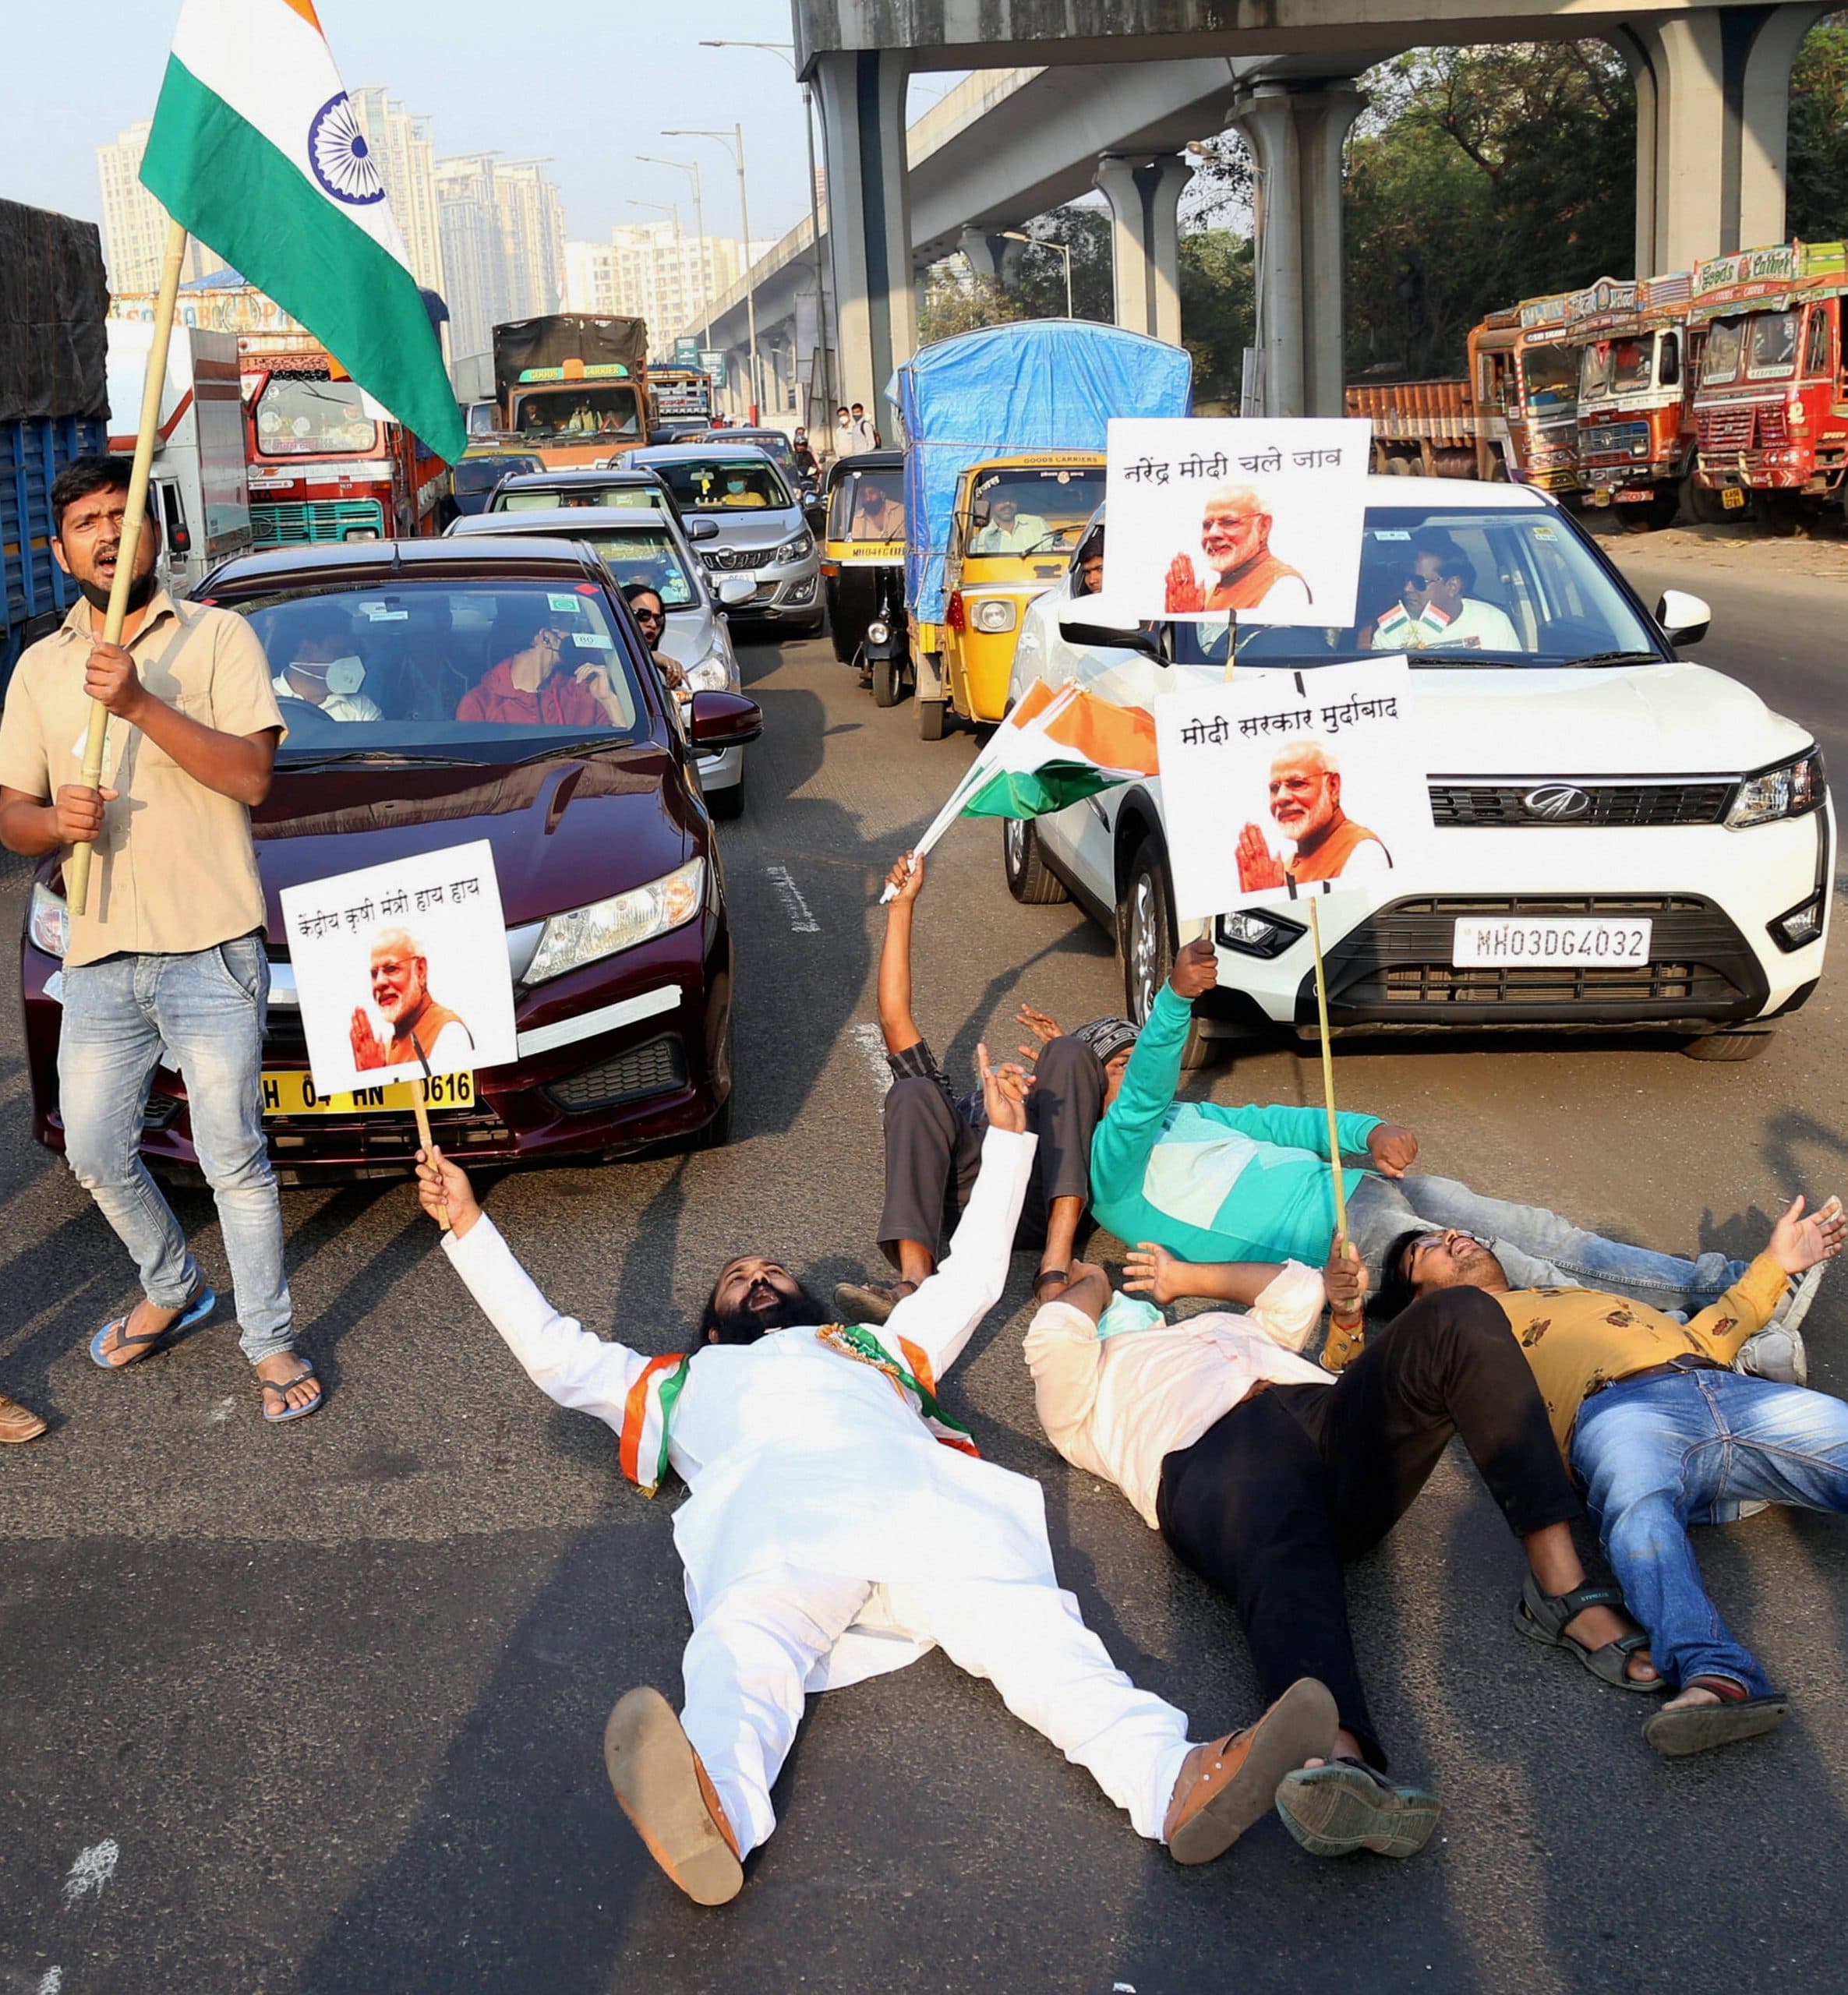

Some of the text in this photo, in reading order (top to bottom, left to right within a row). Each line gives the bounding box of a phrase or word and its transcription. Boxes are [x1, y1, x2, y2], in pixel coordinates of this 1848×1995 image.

[1124, 446, 1343, 486] नरेंद्र मोदी चले जाव
[1181, 693, 1399, 746] मोदी सरकार मुर्दाबाद
[344, 897, 375, 934] कृषी
[380, 888, 408, 916] मंत्री
[414, 886, 443, 912] हाय
[449, 877, 479, 903] हाय
[1477, 930, 1644, 957] MH03DG4032
